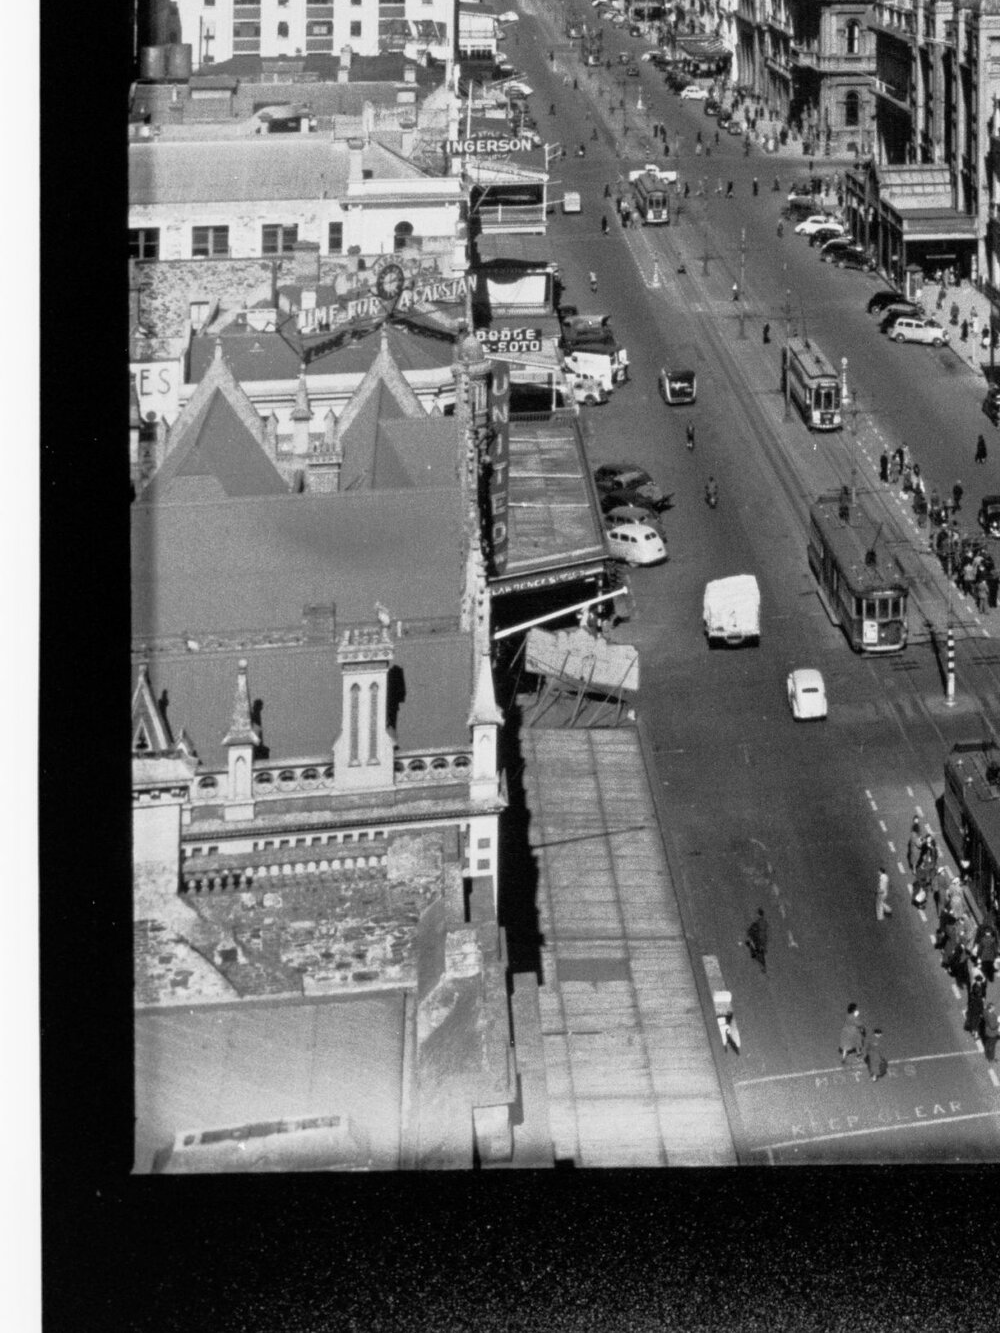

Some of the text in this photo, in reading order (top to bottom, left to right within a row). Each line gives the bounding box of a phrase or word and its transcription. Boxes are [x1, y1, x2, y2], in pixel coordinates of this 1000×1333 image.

[446, 138, 532, 153] INGERSON
[476, 328, 537, 341] DODGE
[491, 374, 509, 541] UNITED
[815, 1065, 918, 1088] MOTRS
